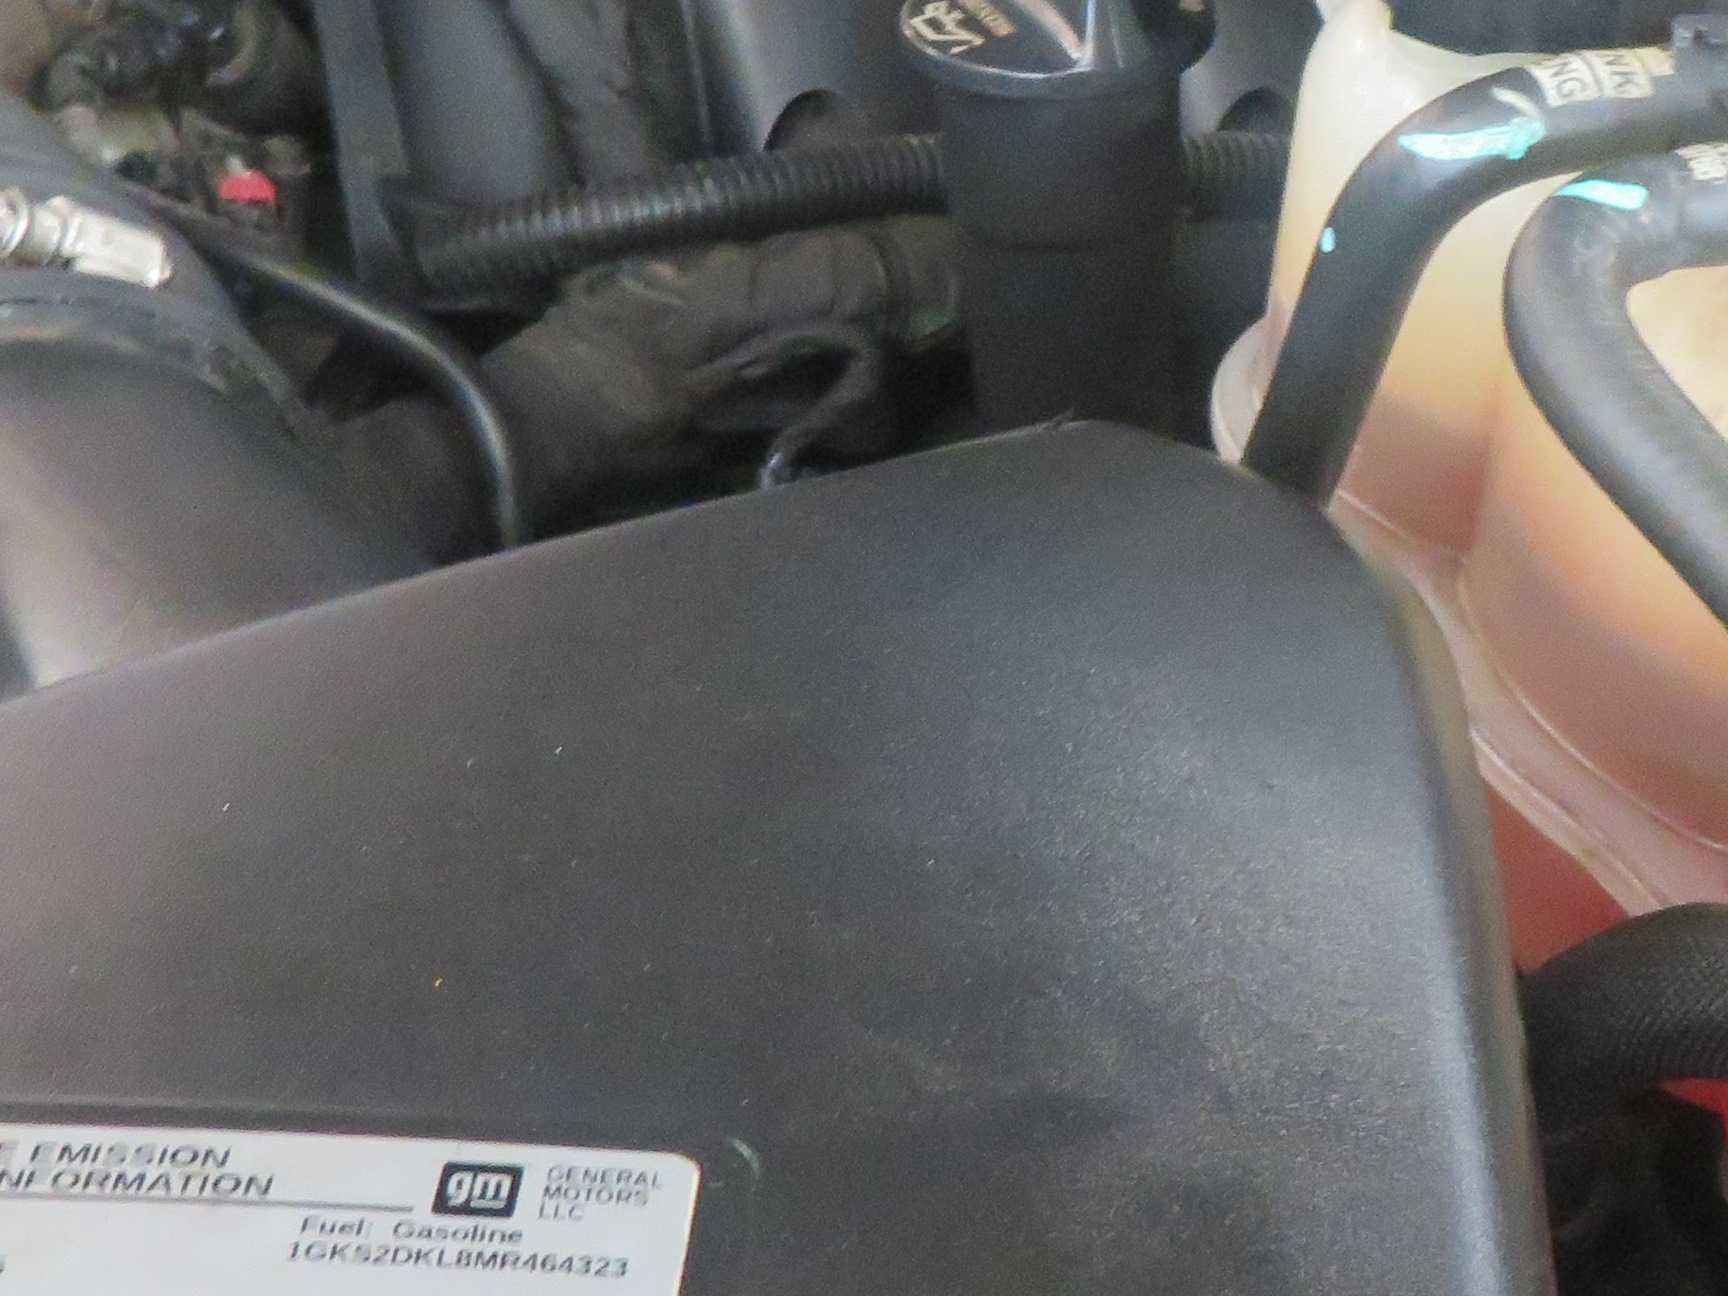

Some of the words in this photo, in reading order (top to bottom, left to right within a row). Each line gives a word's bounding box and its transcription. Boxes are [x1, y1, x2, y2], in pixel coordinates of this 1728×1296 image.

[30, 1141, 232, 1169] EMISSION
[547, 1165, 664, 1191] GENERAL
[542, 1184, 652, 1207] MOTORS
[537, 1204, 585, 1223] LLC
[392, 1220, 525, 1245] Gasoline
